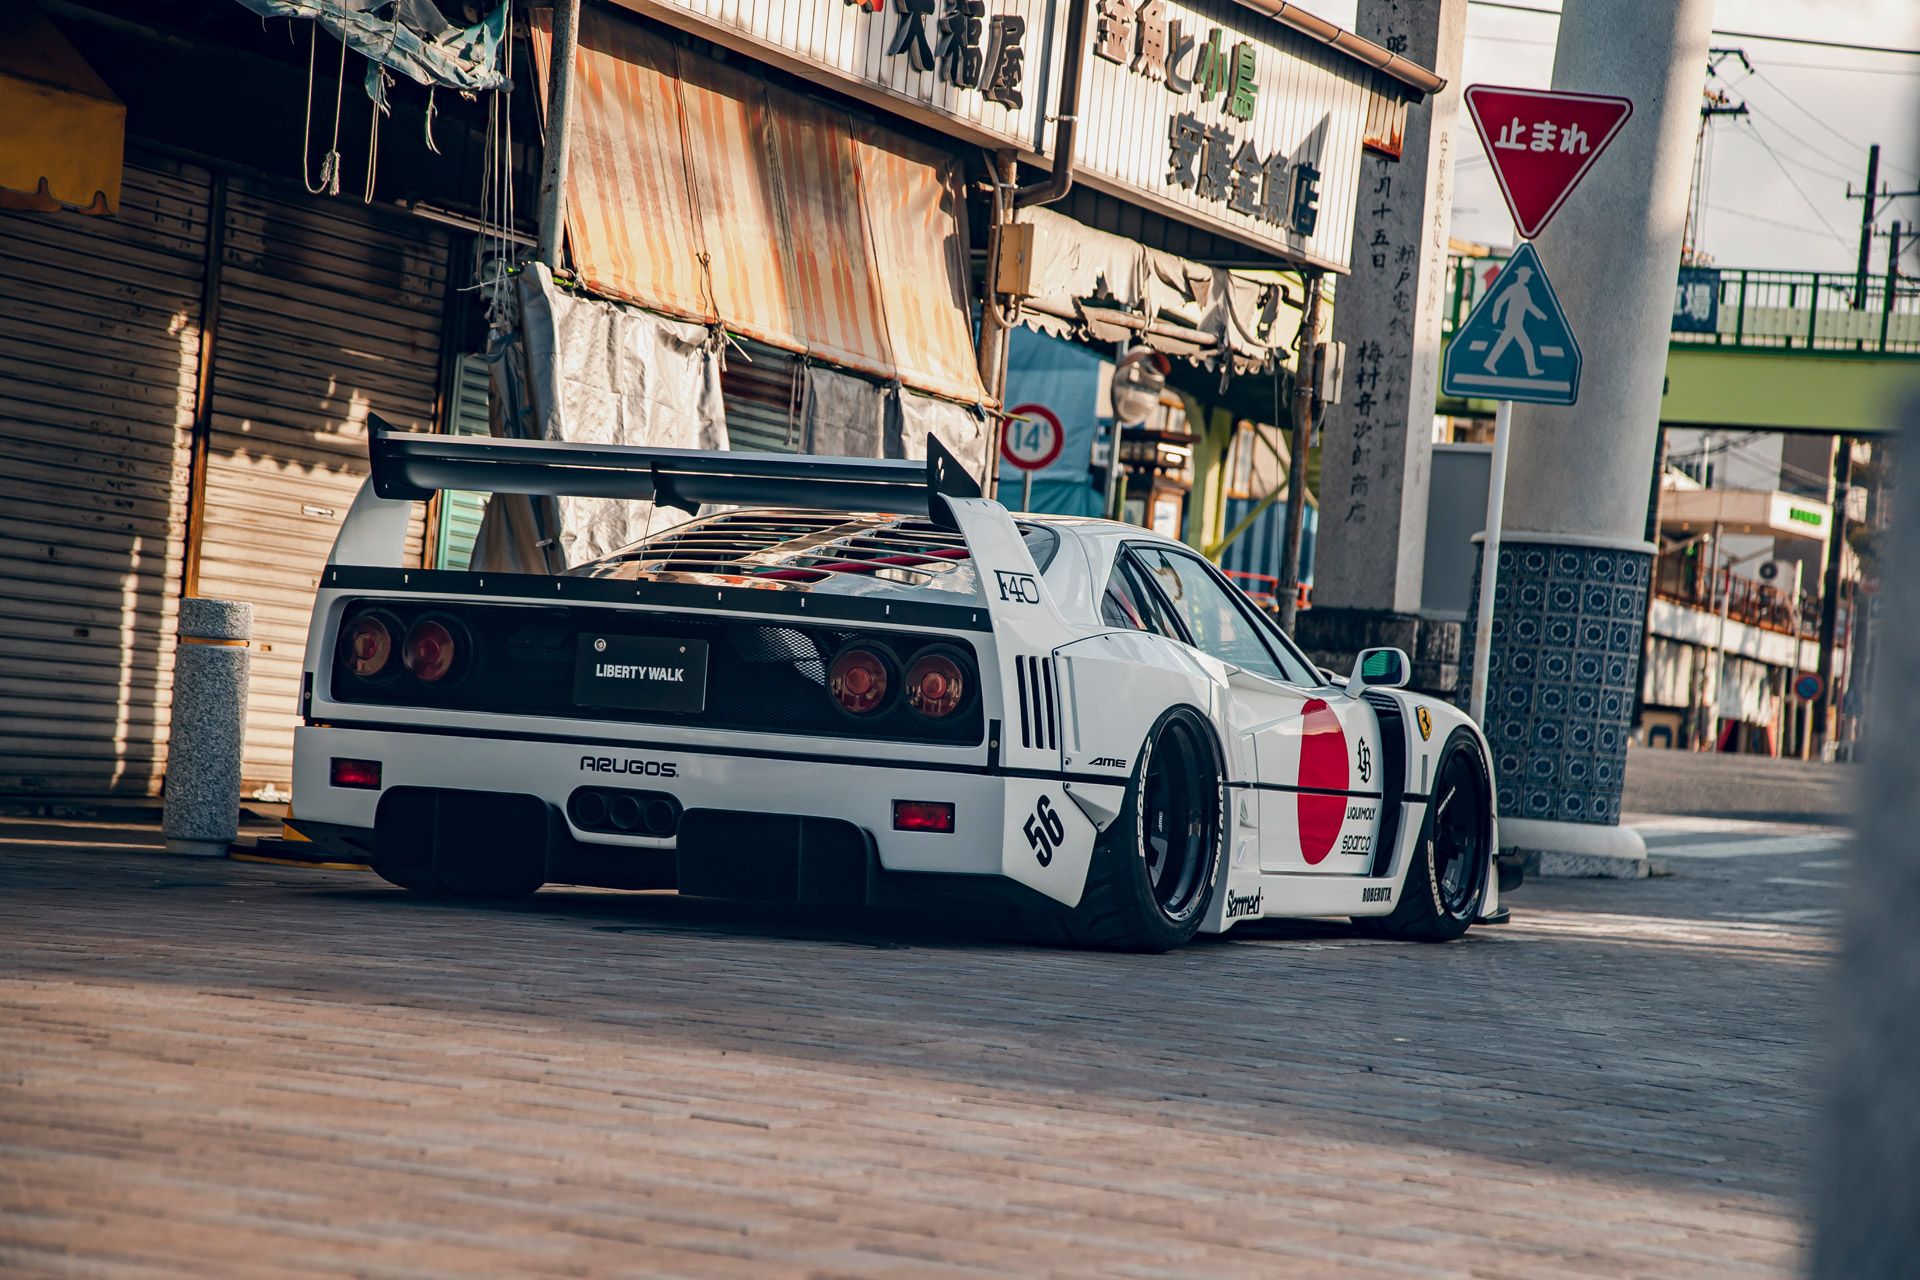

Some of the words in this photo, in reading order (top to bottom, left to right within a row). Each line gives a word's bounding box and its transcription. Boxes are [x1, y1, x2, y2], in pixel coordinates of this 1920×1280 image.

[1093, 0, 1259, 122] 金魚と小鳥
[1494, 116, 1591, 155] 止まれ
[993, 569, 1040, 604] F40
[595, 663, 647, 680] LIBERTY
[648, 666, 684, 682] WALK
[1088, 757, 1126, 768] AME
[1022, 794, 1065, 868] 56
[1341, 834, 1372, 856] sparco
